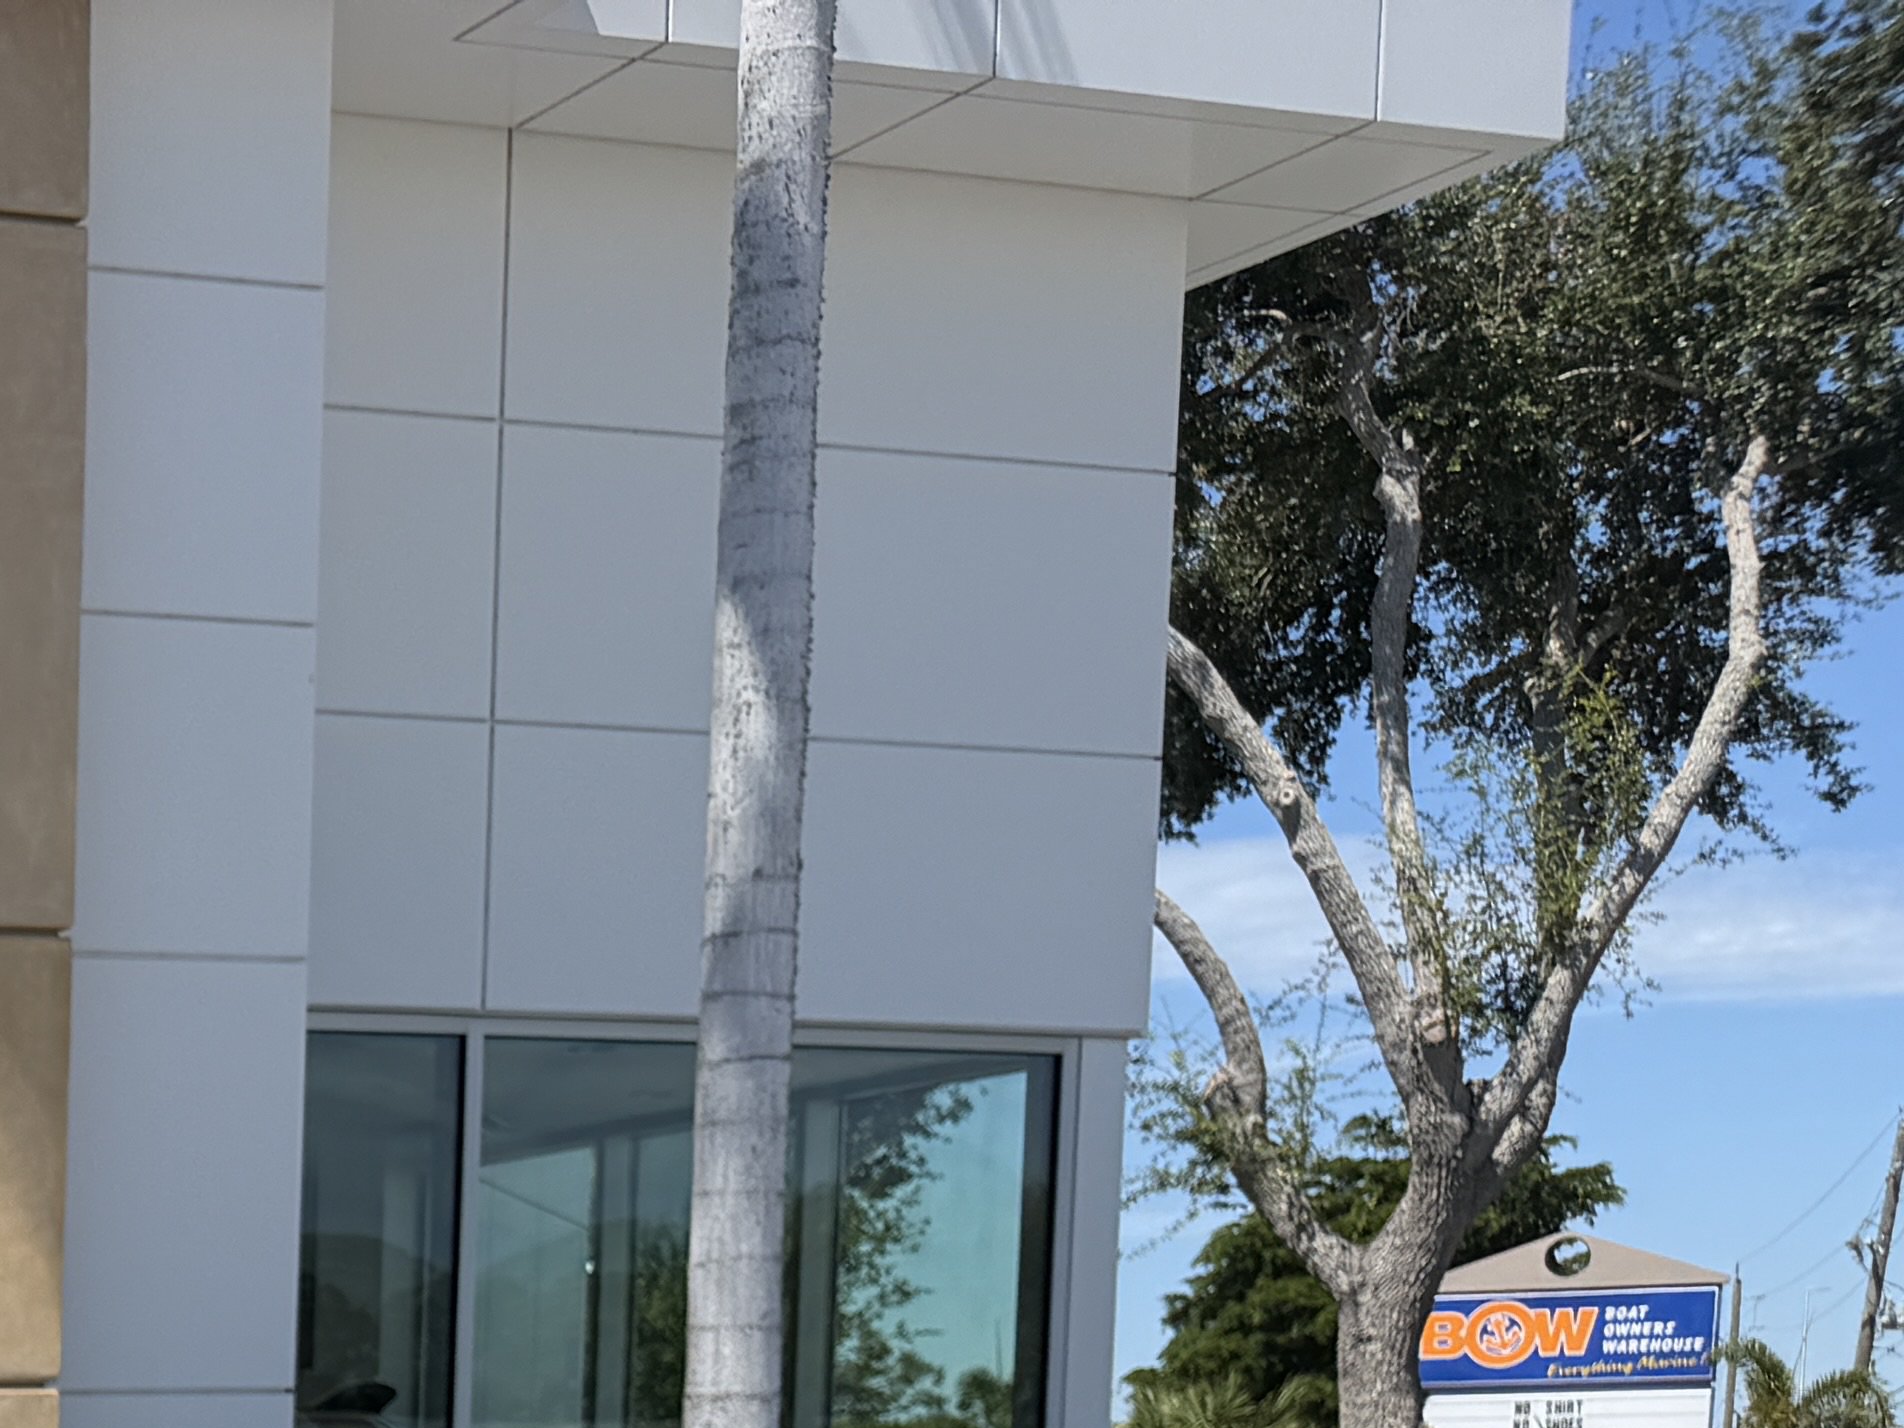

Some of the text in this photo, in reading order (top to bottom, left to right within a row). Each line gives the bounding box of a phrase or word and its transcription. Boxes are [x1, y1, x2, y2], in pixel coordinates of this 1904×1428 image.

[1605, 1304, 1650, 1321] BOAT
[1418, 1300, 1599, 1369] BOW
[1603, 1321, 1676, 1338] OWNERS
[1602, 1337, 1705, 1355] WAREHOUSE
[1547, 1360, 1633, 1377] Everything
[1514, 1399, 1584, 1415] NO SHIRT
